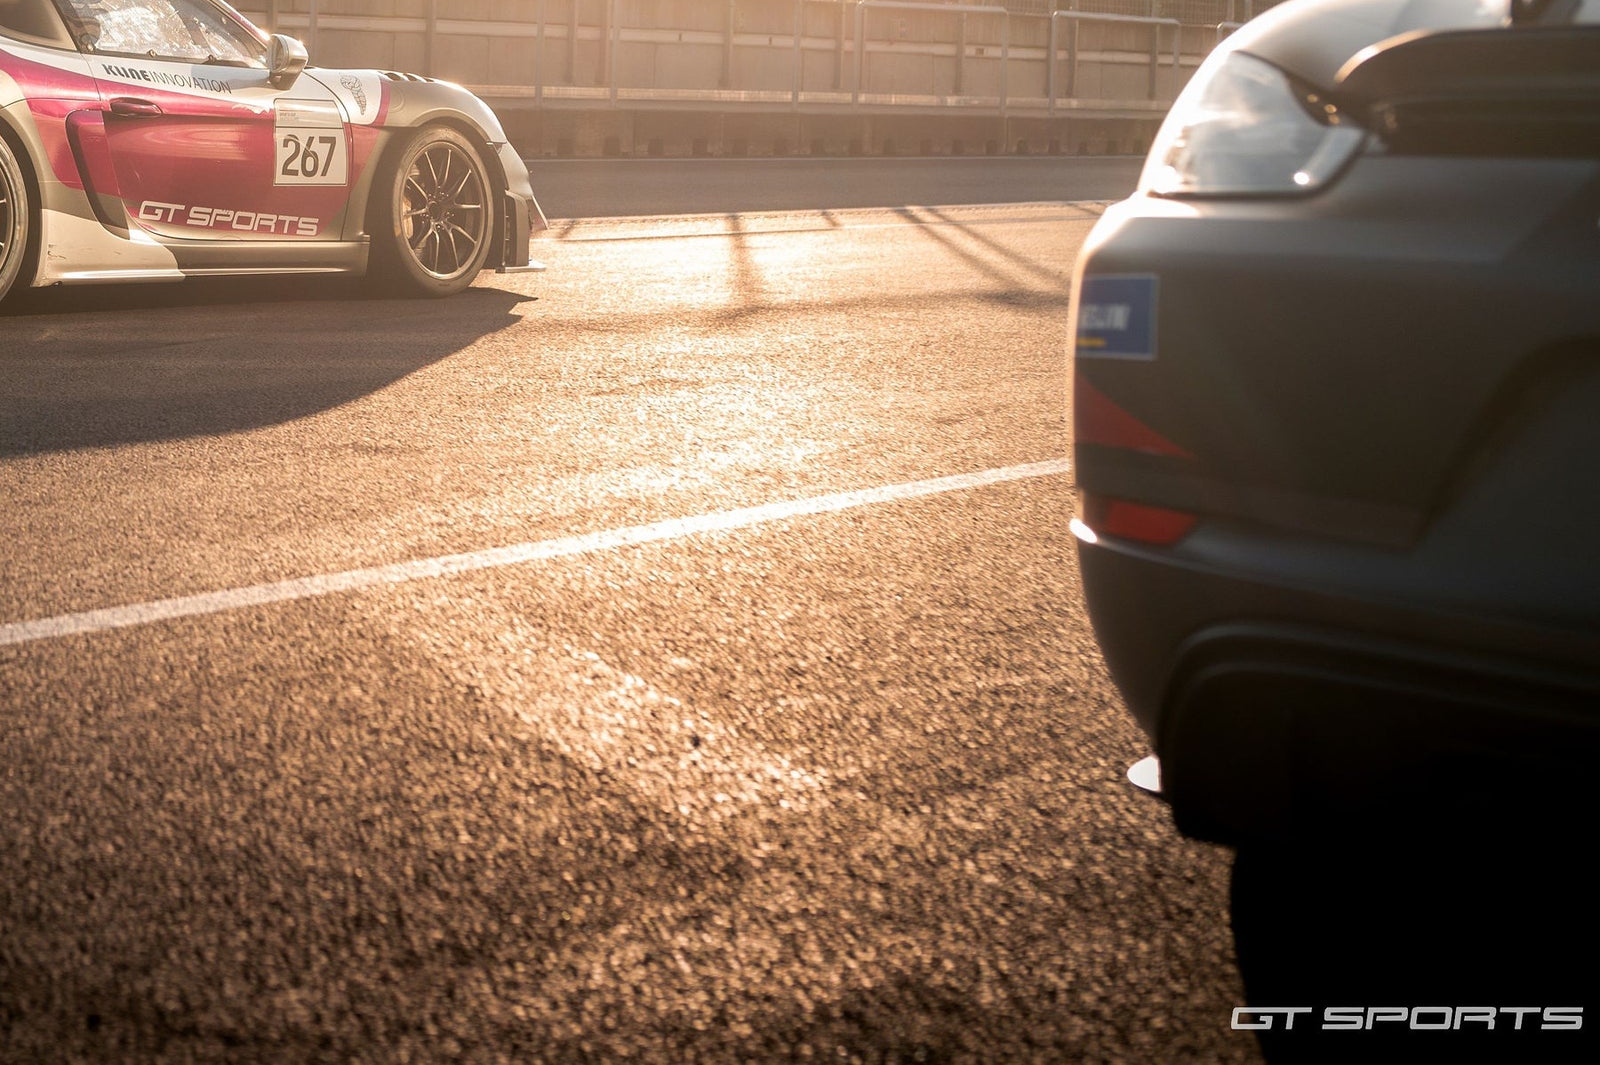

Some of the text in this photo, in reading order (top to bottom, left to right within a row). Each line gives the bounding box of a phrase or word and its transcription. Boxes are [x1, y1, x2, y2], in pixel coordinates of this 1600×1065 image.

[281, 134, 337, 178] 267
[138, 200, 320, 236] GT SPORTS
